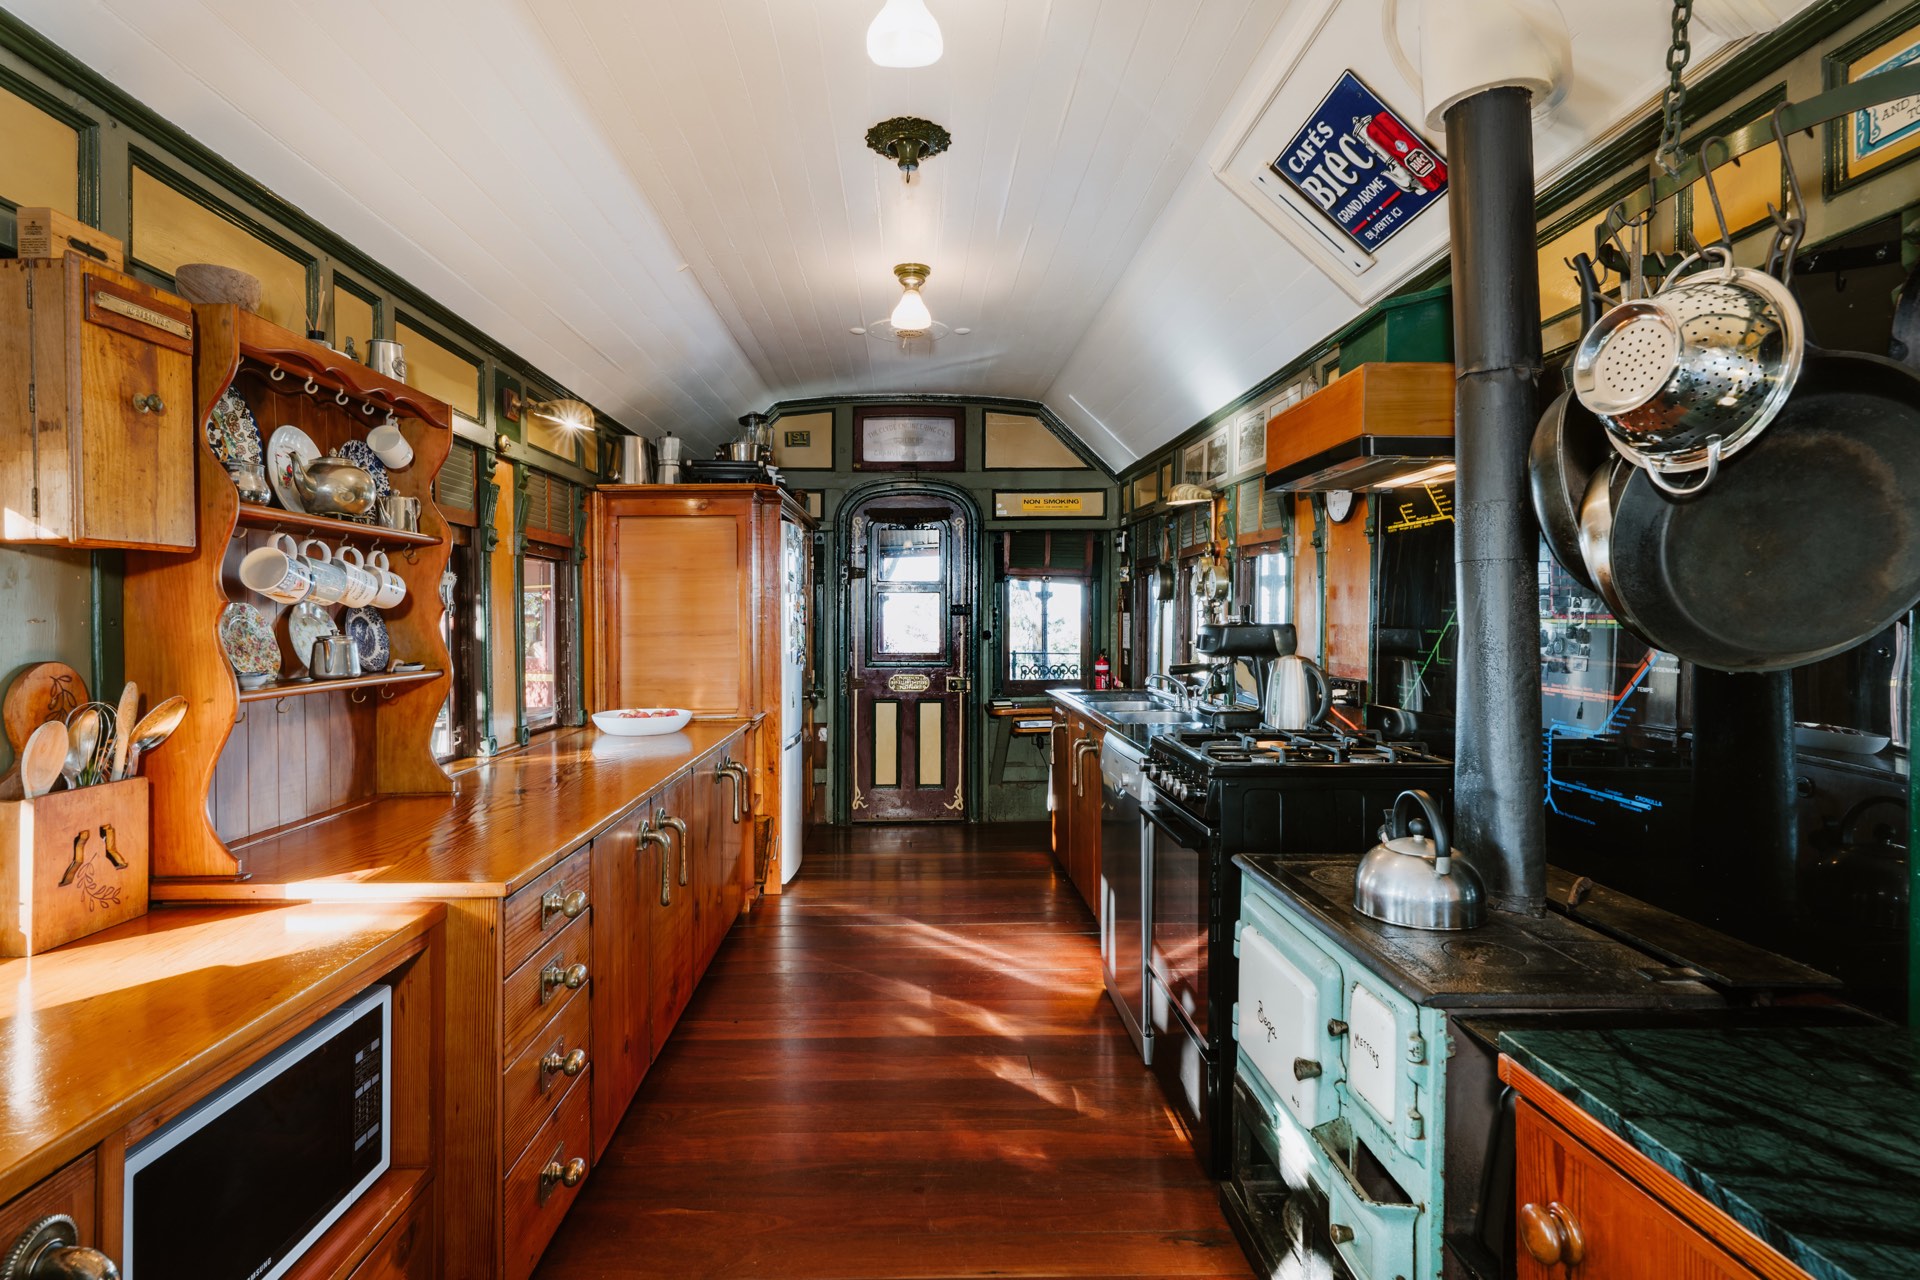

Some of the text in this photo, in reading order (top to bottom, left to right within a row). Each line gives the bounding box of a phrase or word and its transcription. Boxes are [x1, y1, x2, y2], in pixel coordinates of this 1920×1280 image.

[1881, 98, 1910, 121] AND
[1288, 121, 1334, 173] CAFÉS
[1337, 176, 1387, 224] GRAND AROME
[1371, 214, 1394, 235] VENTE
[1390, 206, 1404, 219] ICI
[878, 423, 897, 434] CLYDE
[1637, 686, 1654, 694] TEMPE
[1353, 1032, 1380, 1069] METTERS
[247, 1256, 272, 1280] MSUNG
